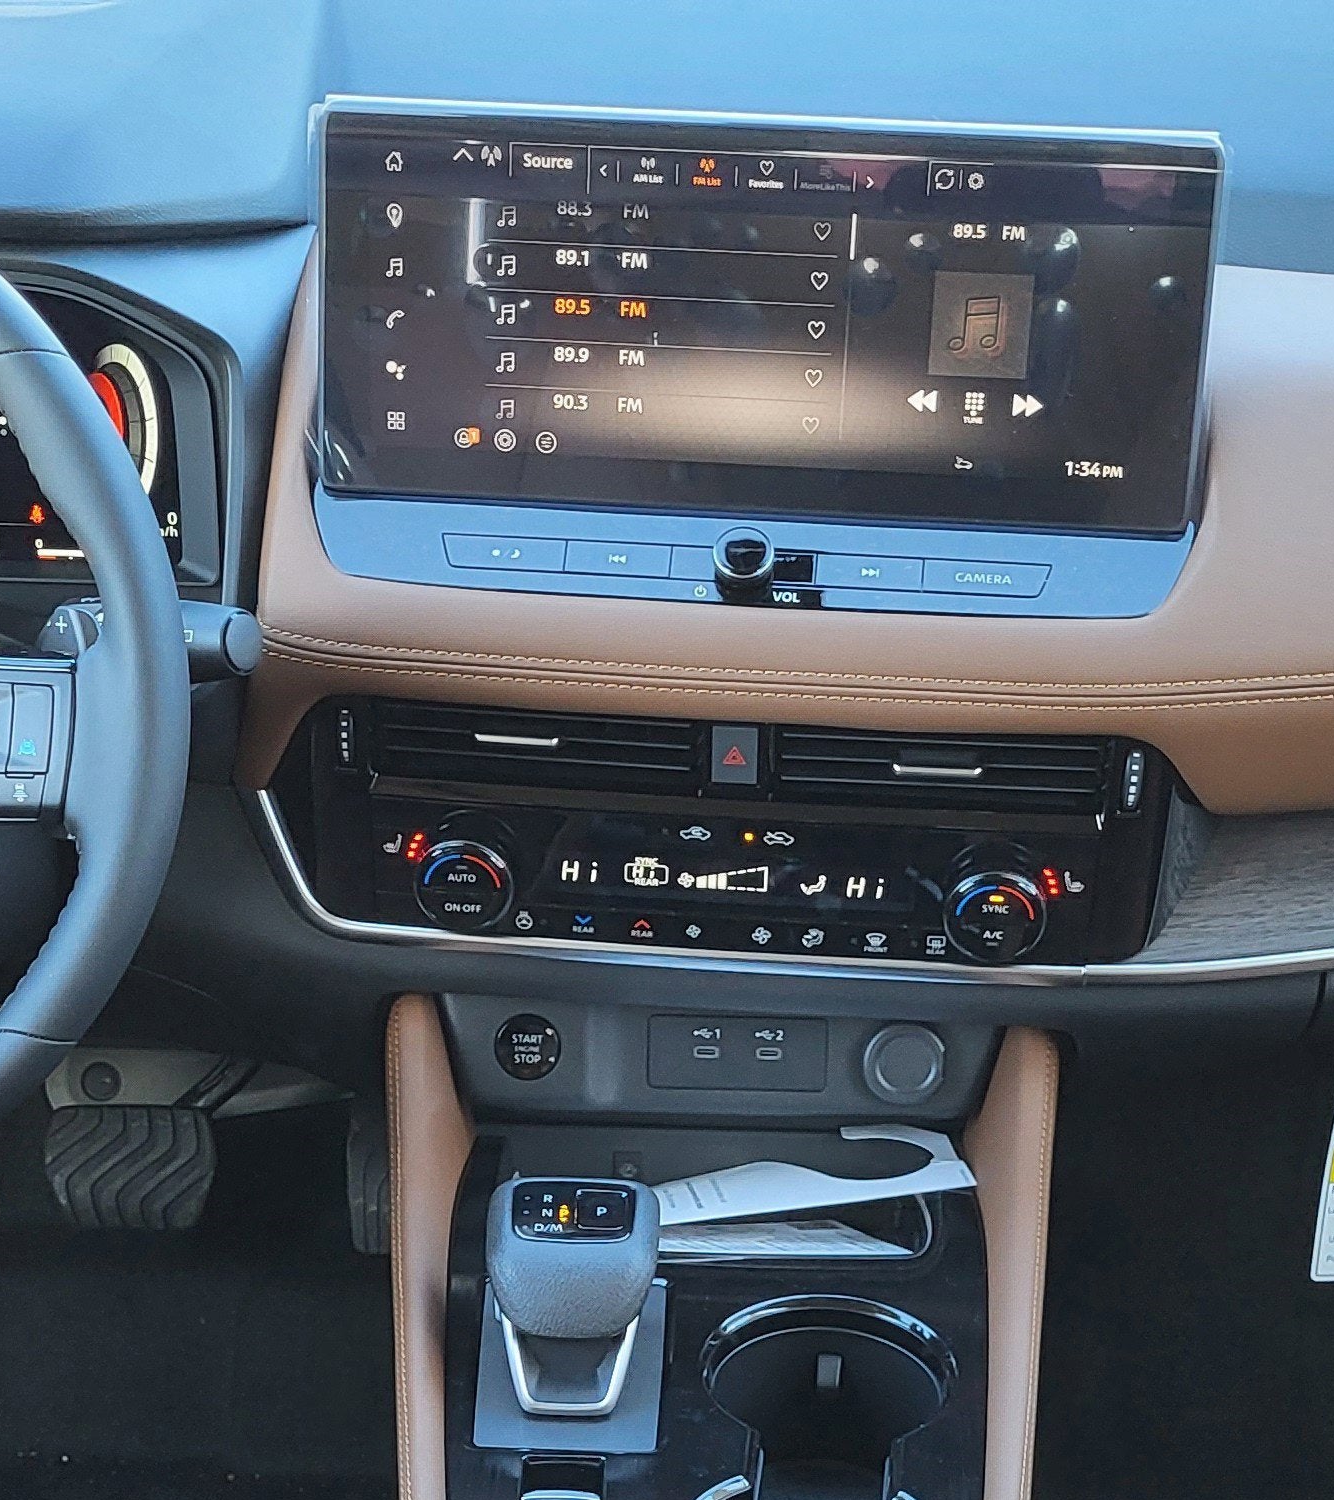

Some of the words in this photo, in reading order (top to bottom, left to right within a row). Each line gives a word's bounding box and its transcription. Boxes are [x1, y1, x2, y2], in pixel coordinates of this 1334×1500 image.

[522, 153, 574, 170] Source
[633, 173, 648, 183] AM
[649, 175, 663, 184] List
[693, 176, 706, 186] FM
[707, 178, 721, 187] List
[748, 179, 784, 190] Favorites
[556, 201, 593, 217] 88.3
[622, 203, 649, 220] FM
[953, 224, 987, 240] 89.5
[1002, 225, 1026, 241] FM
[555, 250, 591, 266] 89.1
[621, 252, 648, 270] FM
[554, 298, 591, 315] 89.5
[619, 301, 647, 318] FM
[553, 347, 590, 363] 89.9
[618, 349, 645, 366] FM
[552, 394, 589, 411] 90.3
[617, 398, 643, 414] FM
[1064, 460, 1101, 478] 1:34
[1102, 465, 1124, 479] PM
[167, 511, 178, 526] 0
[34, 538, 44, 549] 0
[954, 571, 1013, 587] CAMERA
[772, 591, 801, 604] VOL
[447, 873, 477, 883] AUTO
[981, 904, 1009, 915] SYNC
[982, 930, 1004, 940] A/C
[511, 1033, 544, 1044] START
[713, 1028, 721, 1039] 1
[774, 1029, 784, 1041] 2
[514, 1053, 542, 1064] STOP
[542, 1194, 554, 1203] R
[541, 1208, 554, 1218] N
[596, 1206, 608, 1217] P
[533, 1223, 563, 1233] D/M
